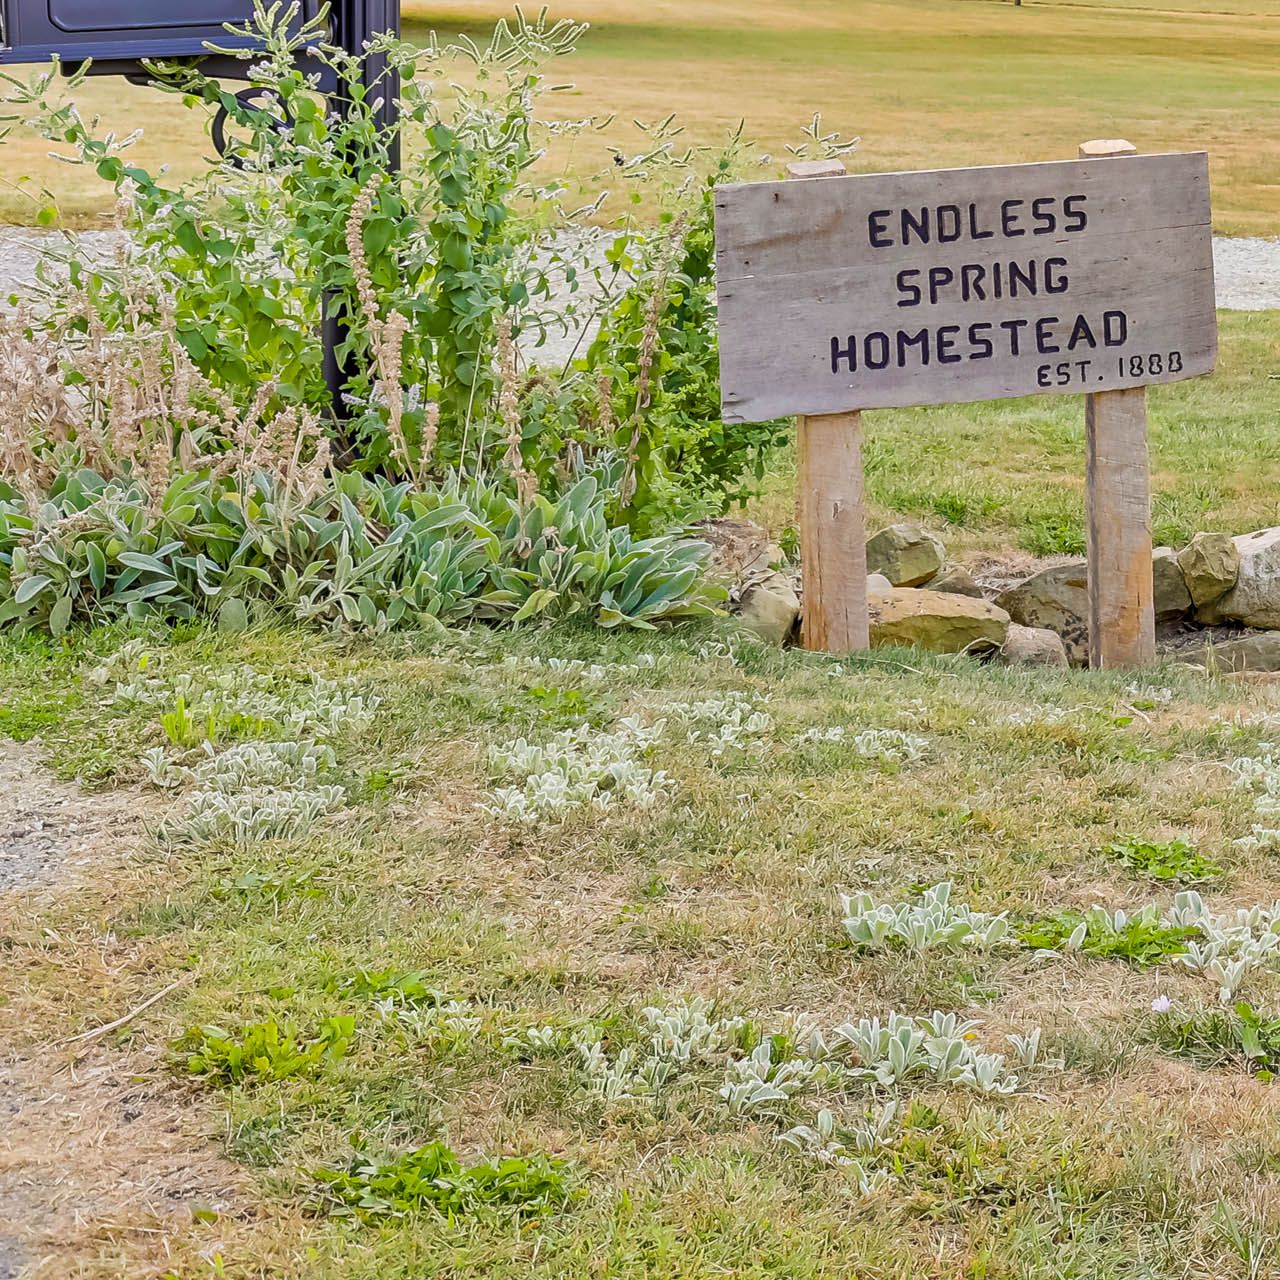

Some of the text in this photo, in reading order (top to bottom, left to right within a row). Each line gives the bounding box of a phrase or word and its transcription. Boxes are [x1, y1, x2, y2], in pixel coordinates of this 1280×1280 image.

[867, 194, 1087, 248] ENDLESS
[896, 257, 1069, 308] SPRING
[830, 310, 1128, 374] HOMESTEAD
[1037, 351, 1183, 387] EST. 1888
